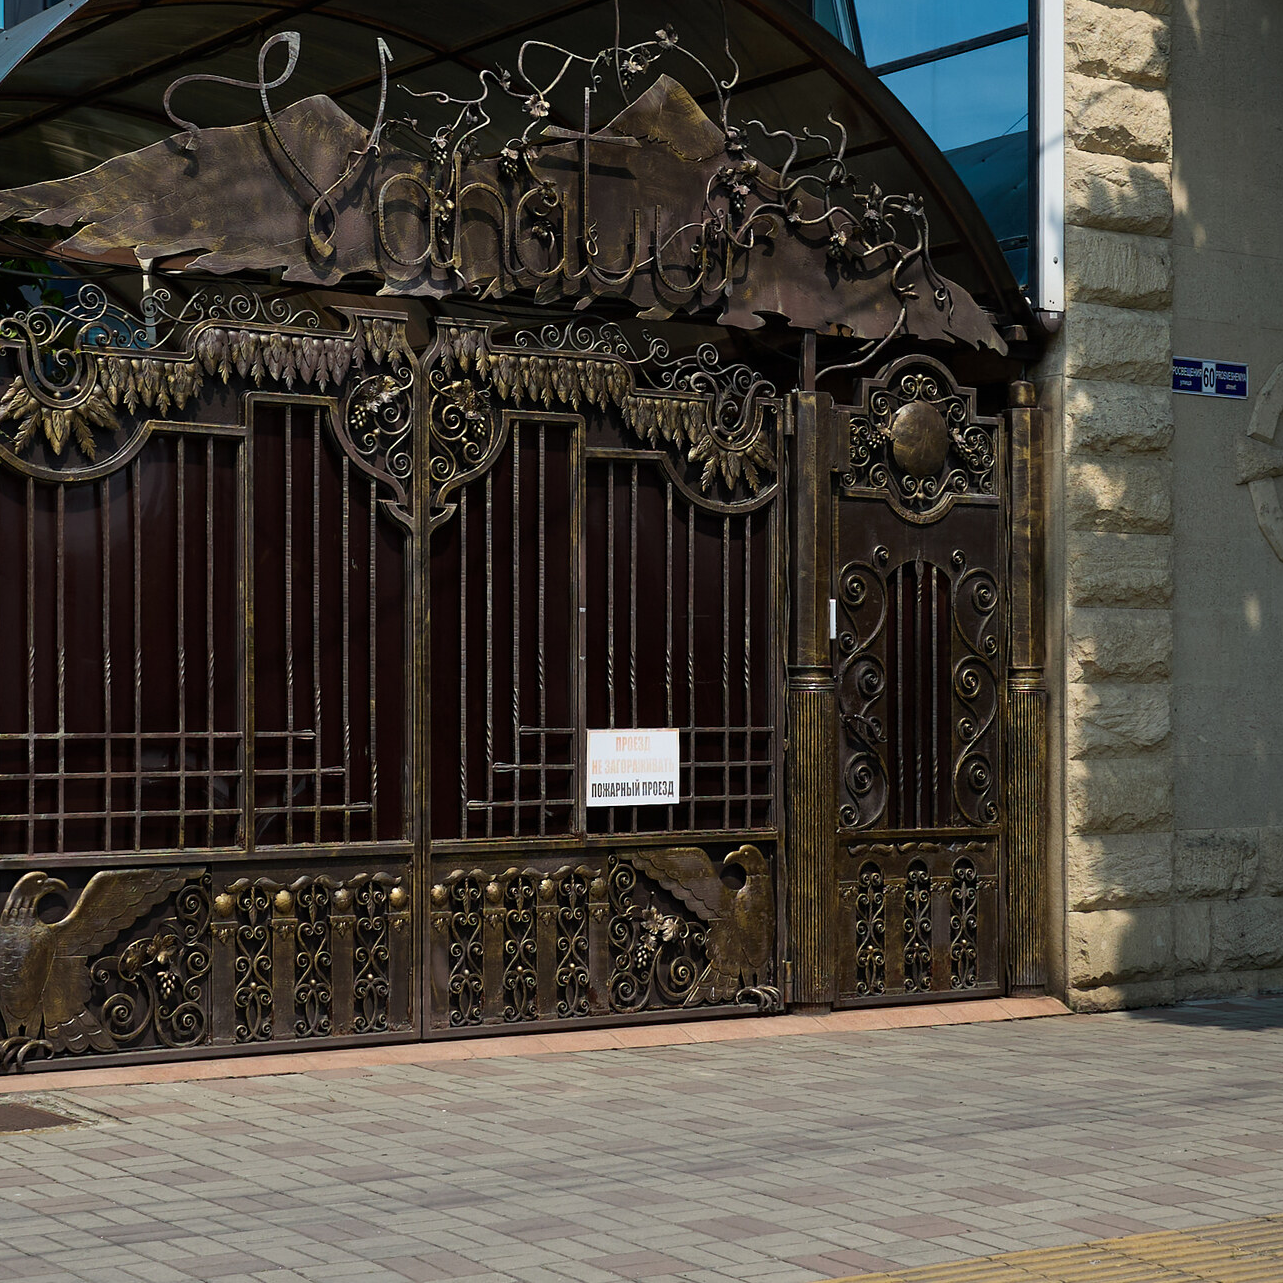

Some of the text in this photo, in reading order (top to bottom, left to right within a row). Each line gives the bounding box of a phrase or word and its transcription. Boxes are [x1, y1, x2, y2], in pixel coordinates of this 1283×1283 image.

[1172, 366, 1202, 378] РОСВЕЩЕНИЯ
[1203, 367, 1215, 388] 60
[615, 736, 651, 752] ПРОЕЗД
[592, 758, 675, 774] НЕ ЗАГОРАЖИВАТЬ
[591, 779, 674, 798] ПОЖАРНЫЙ ПРОЕЗД
